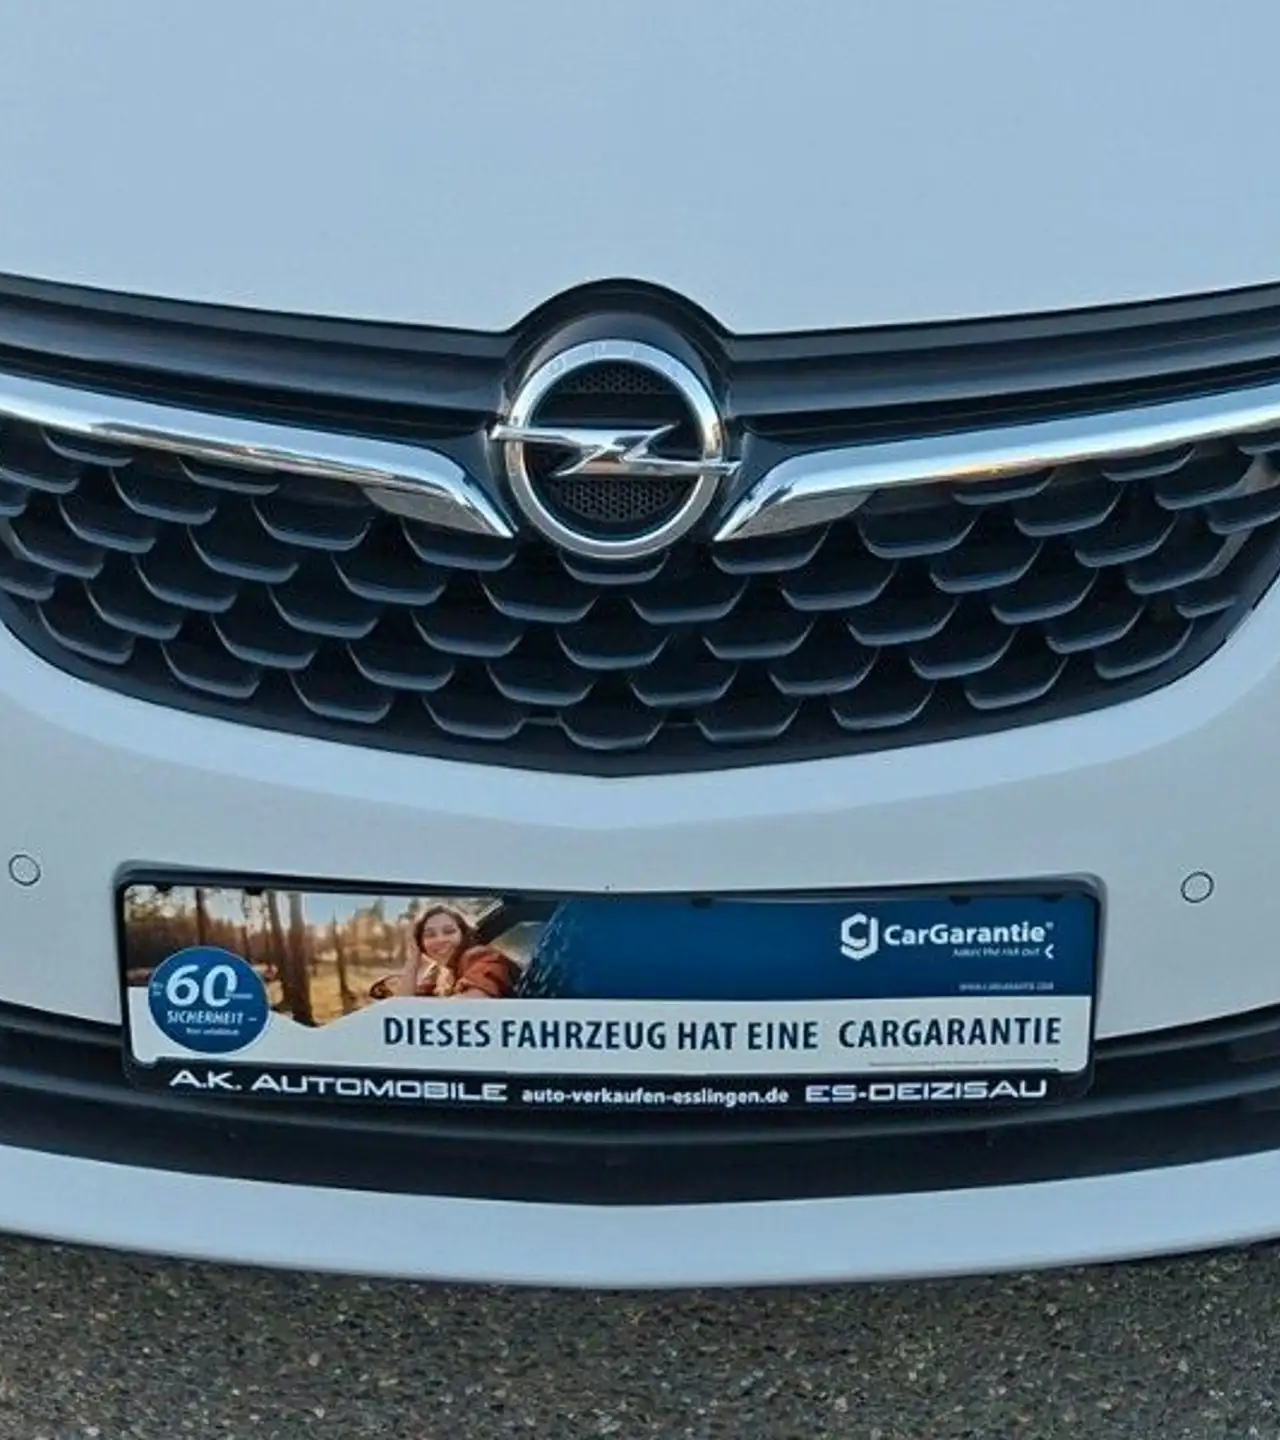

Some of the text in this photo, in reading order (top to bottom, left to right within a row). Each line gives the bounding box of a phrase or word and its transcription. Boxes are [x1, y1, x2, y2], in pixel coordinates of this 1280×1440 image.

[883, 921, 1046, 946] CarGarantie
[166, 964, 238, 1008] 60
[383, 1017, 1062, 1051] DIESES FAHRZEUG HAT EINE CARGARANTIE
[170, 1069, 1048, 1109] A.K. AUTOMOBILE auto-verkaufen-esslingen.de ES-DEIZISAU
